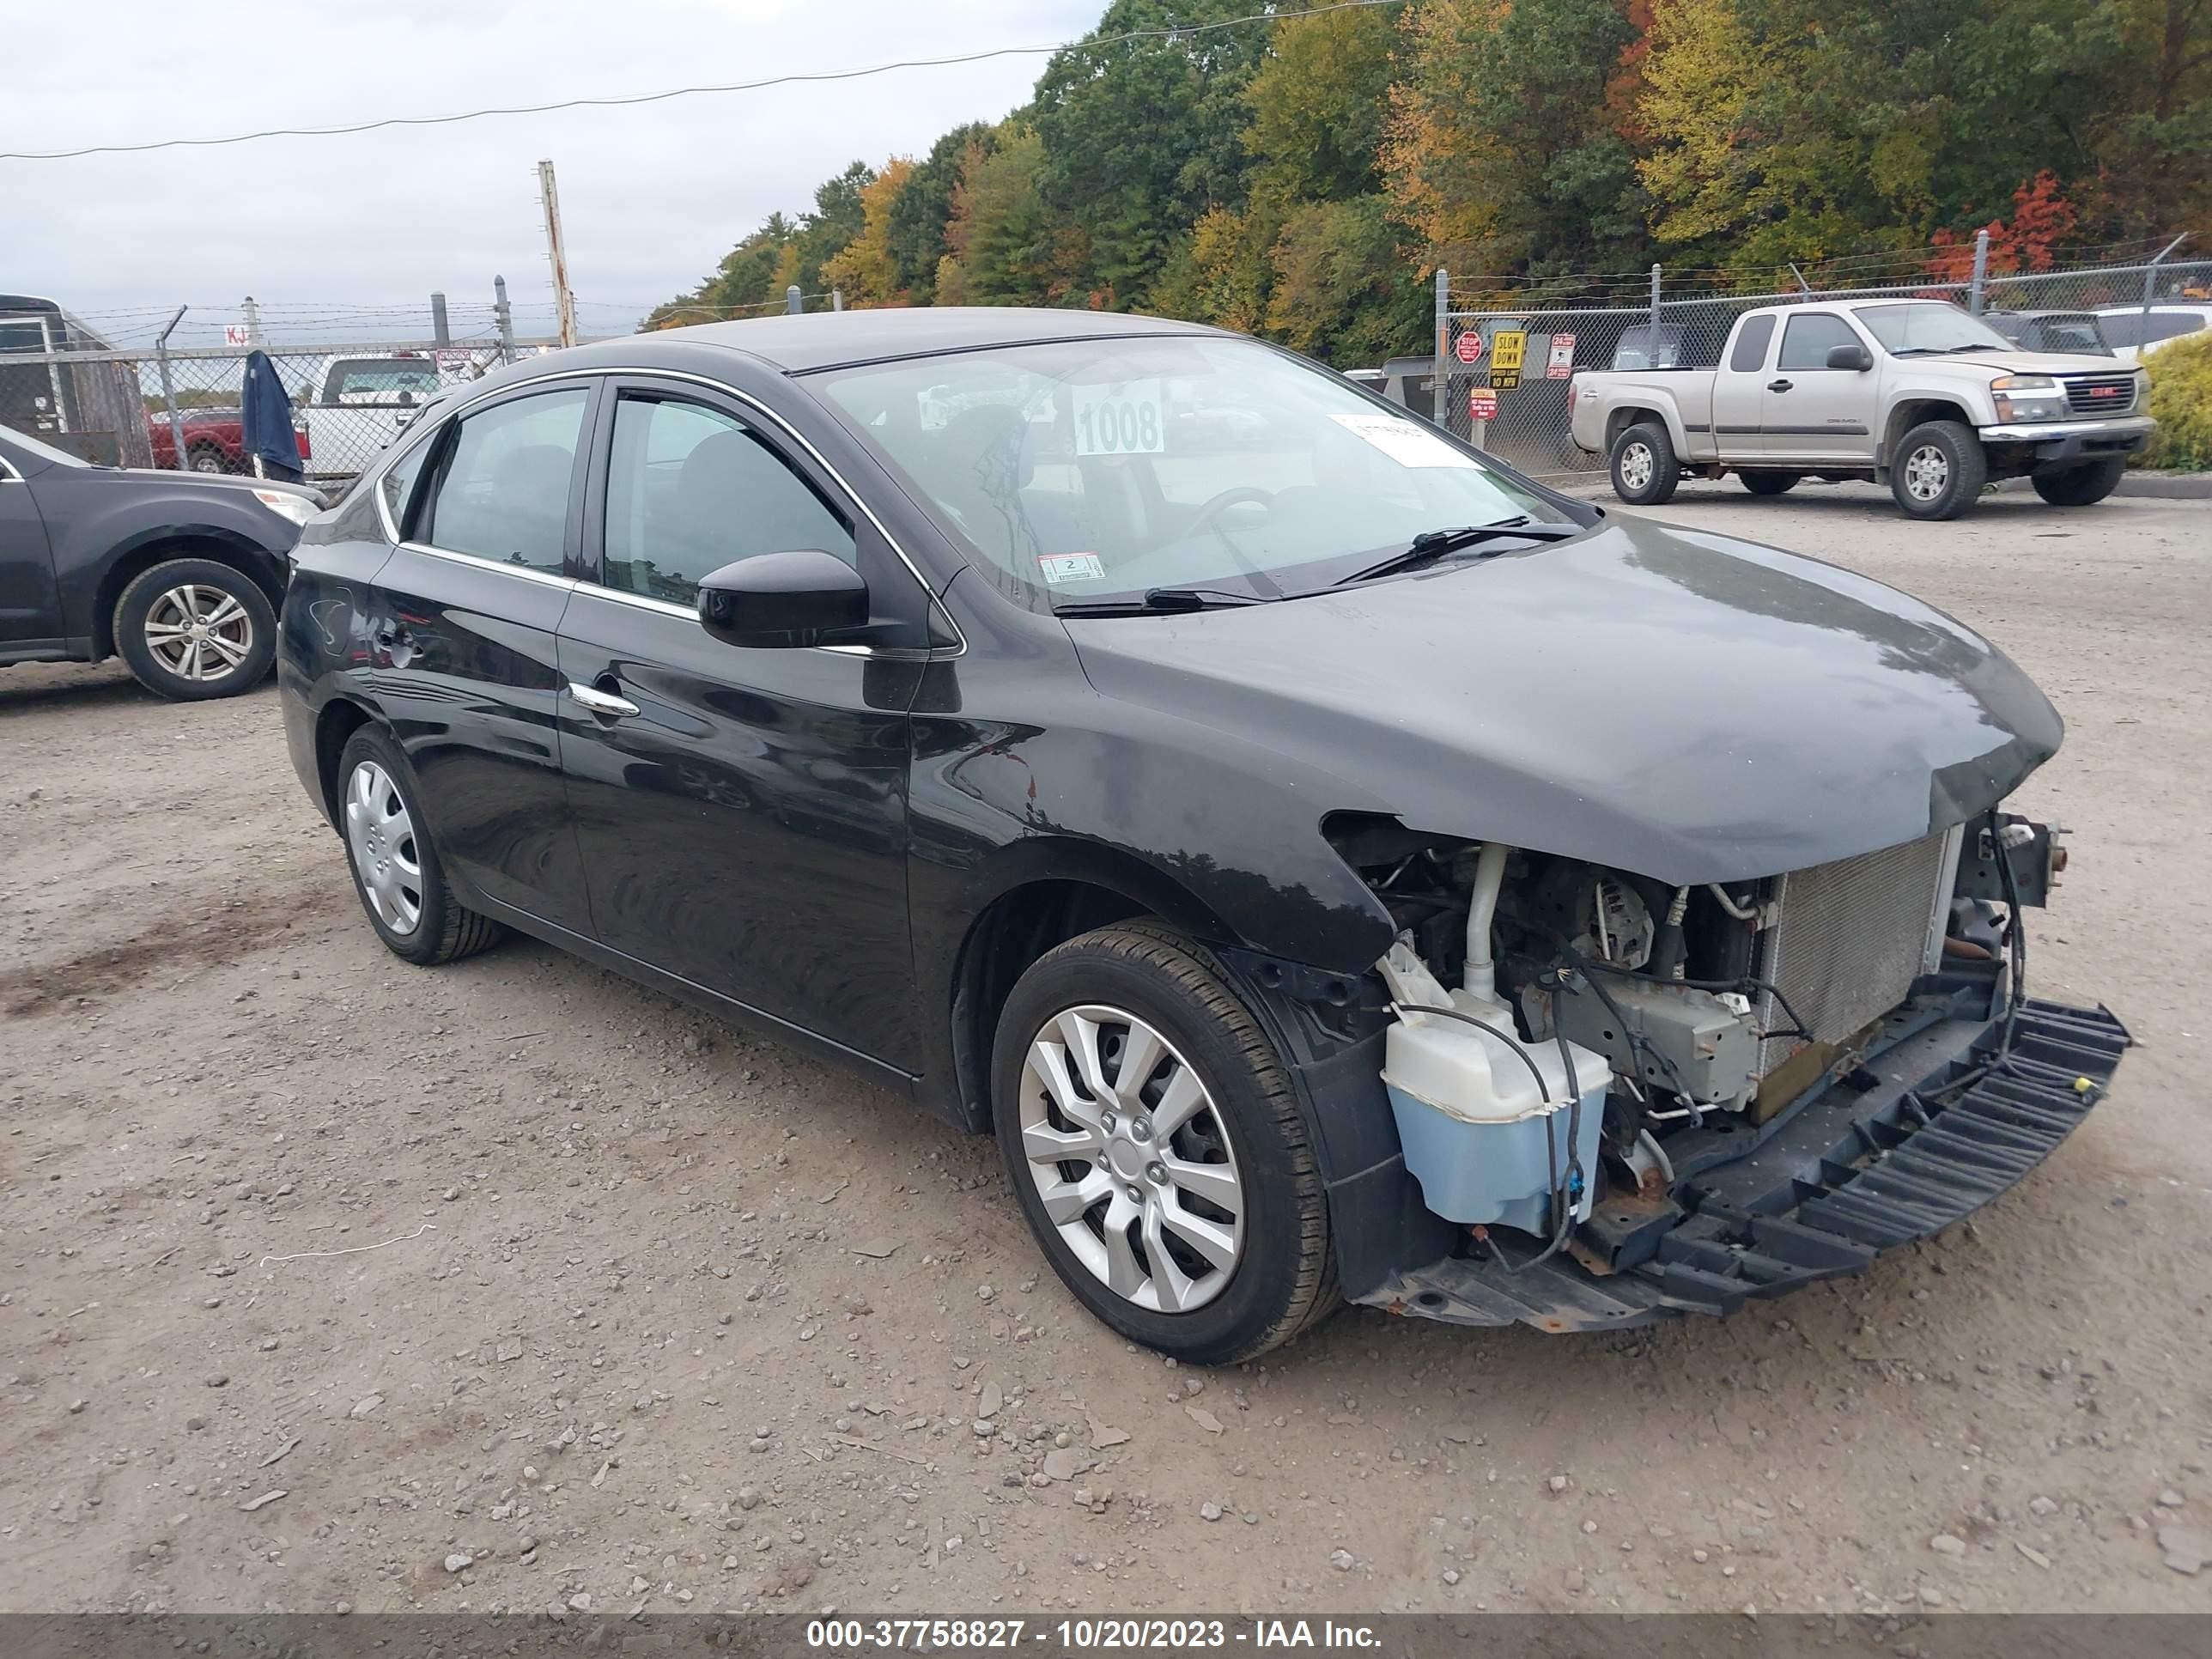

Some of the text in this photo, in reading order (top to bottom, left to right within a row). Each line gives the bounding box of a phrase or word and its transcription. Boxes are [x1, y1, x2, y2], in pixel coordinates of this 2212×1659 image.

[1461, 337, 1479, 345] STOP
[1498, 337, 1519, 349] SLOW
[1496, 352, 1518, 364] DOWN
[1492, 377, 1502, 386] 10
[1079, 401, 1158, 453] 1008
[1065, 560, 1076, 569] 2
